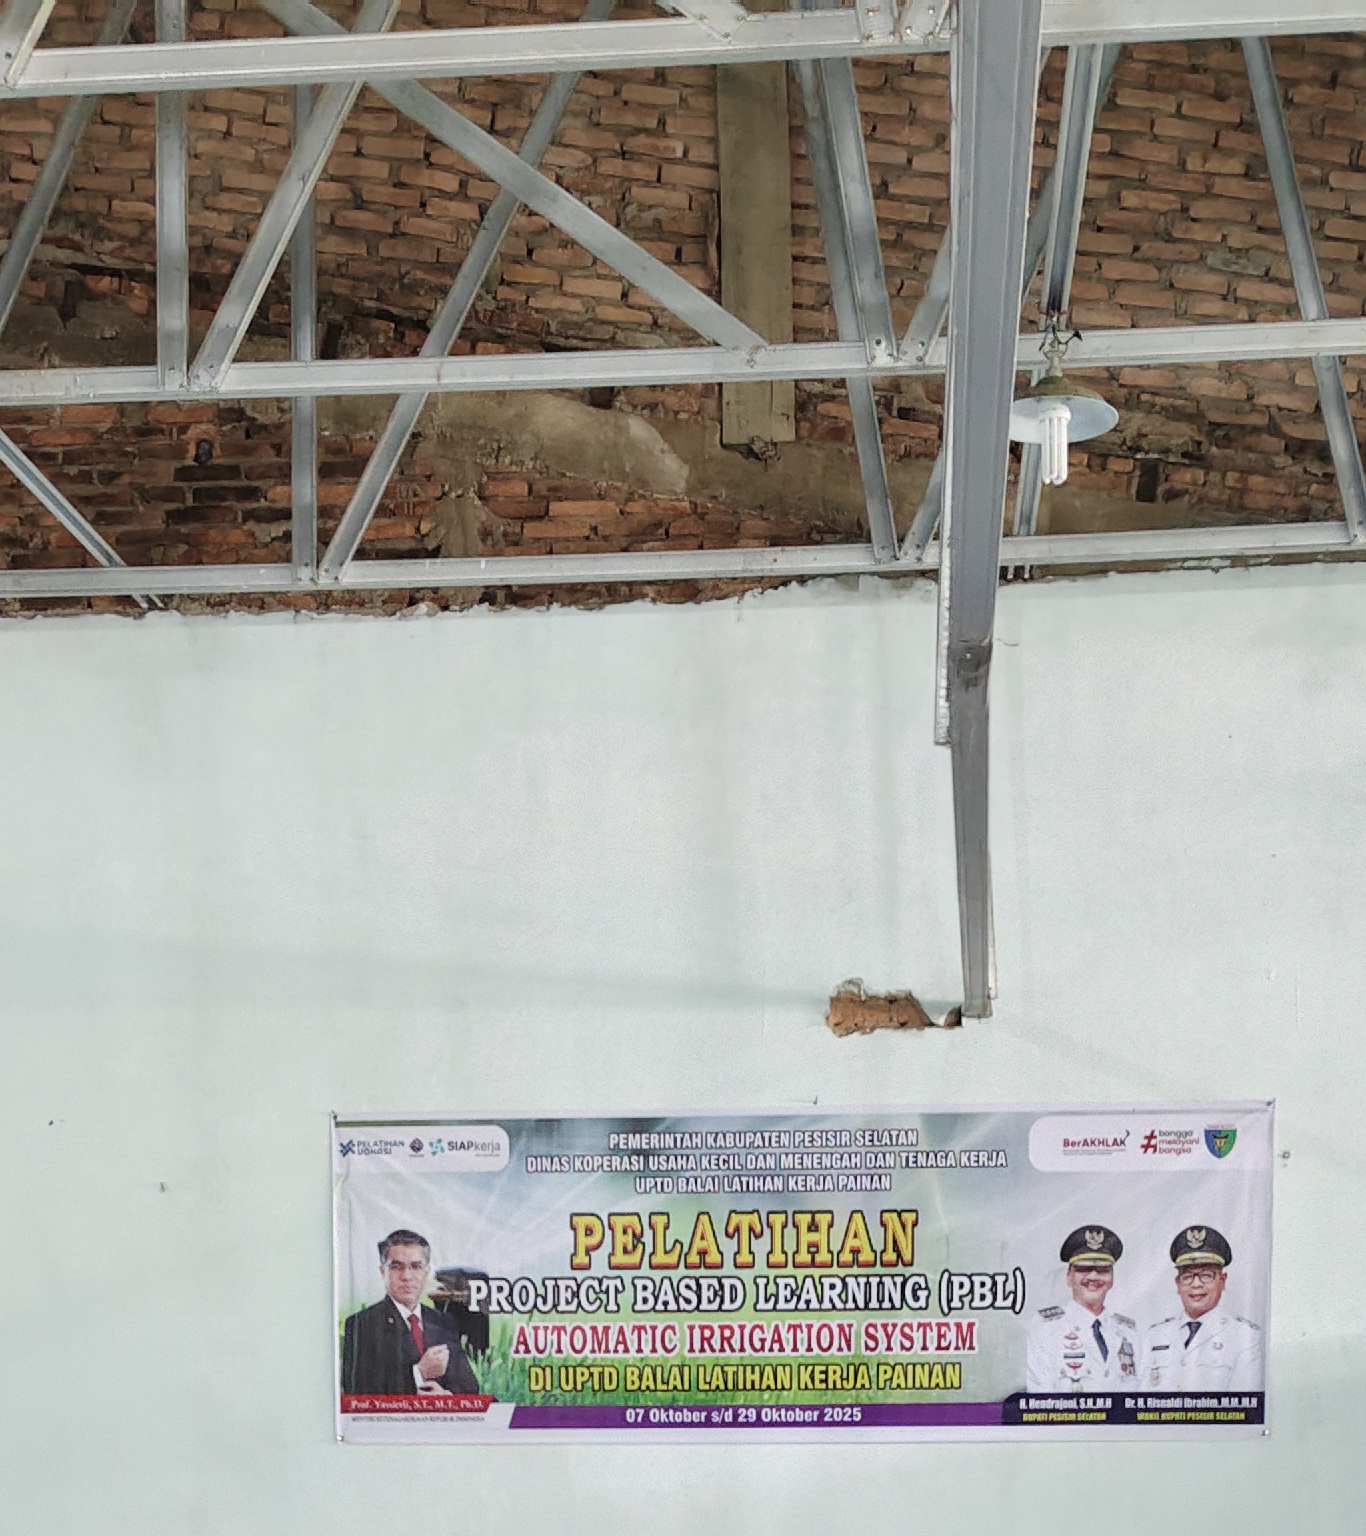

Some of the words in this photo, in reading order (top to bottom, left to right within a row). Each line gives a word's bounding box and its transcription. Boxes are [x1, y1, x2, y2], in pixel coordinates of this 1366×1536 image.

[609, 1133, 702, 1150] PEMERINTAH
[706, 1131, 790, 1149] KABUPATEN
[794, 1130, 851, 1148] PESISIR
[855, 1129, 918, 1146] SELATAN
[526, 1155, 570, 1172] DINAS
[574, 1155, 644, 1172] KOPERASI
[649, 1154, 696, 1171] USAHA
[701, 1154, 742, 1170] KECIL
[746, 1153, 775, 1170] DAN
[780, 1153, 861, 1169] MENENGAH
[865, 1152, 895, 1169] DAN
[900, 1151, 956, 1168] TENAGA
[960, 1151, 1007, 1168] KERJA
[636, 1177, 673, 1193] UPTD
[678, 1176, 719, 1193] BALAI
[724, 1175, 784, 1192] LATIHAN
[787, 1175, 834, 1192] KERJA
[838, 1174, 891, 1191] PAINAN
[570, 1210, 918, 1270] PELATIHAN
[467, 1276, 624, 1314] PROJECT
[632, 1276, 747, 1313] BASED
[754, 1273, 931, 1312] LEARNING
[938, 1267, 1026, 1316] (PBL)
[513, 1324, 678, 1354] AUTOMATIC
[687, 1322, 854, 1354] IRRIGATION
[864, 1321, 976, 1352] SYSTEM
[529, 1366, 552, 1391] DI
[559, 1365, 618, 1391] UPTD
[625, 1365, 690, 1391] BALAI
[697, 1364, 792, 1391] LATIHAN
[798, 1363, 871, 1390] KERJA
[877, 1362, 961, 1389] PAINAN
[626, 1408, 645, 1423] 07
[649, 1408, 707, 1423] Oktober
[711, 1408, 734, 1423] s/d
[738, 1408, 756, 1422] 29
[761, 1407, 819, 1422] Oktober
[824, 1407, 862, 1421] 2025
